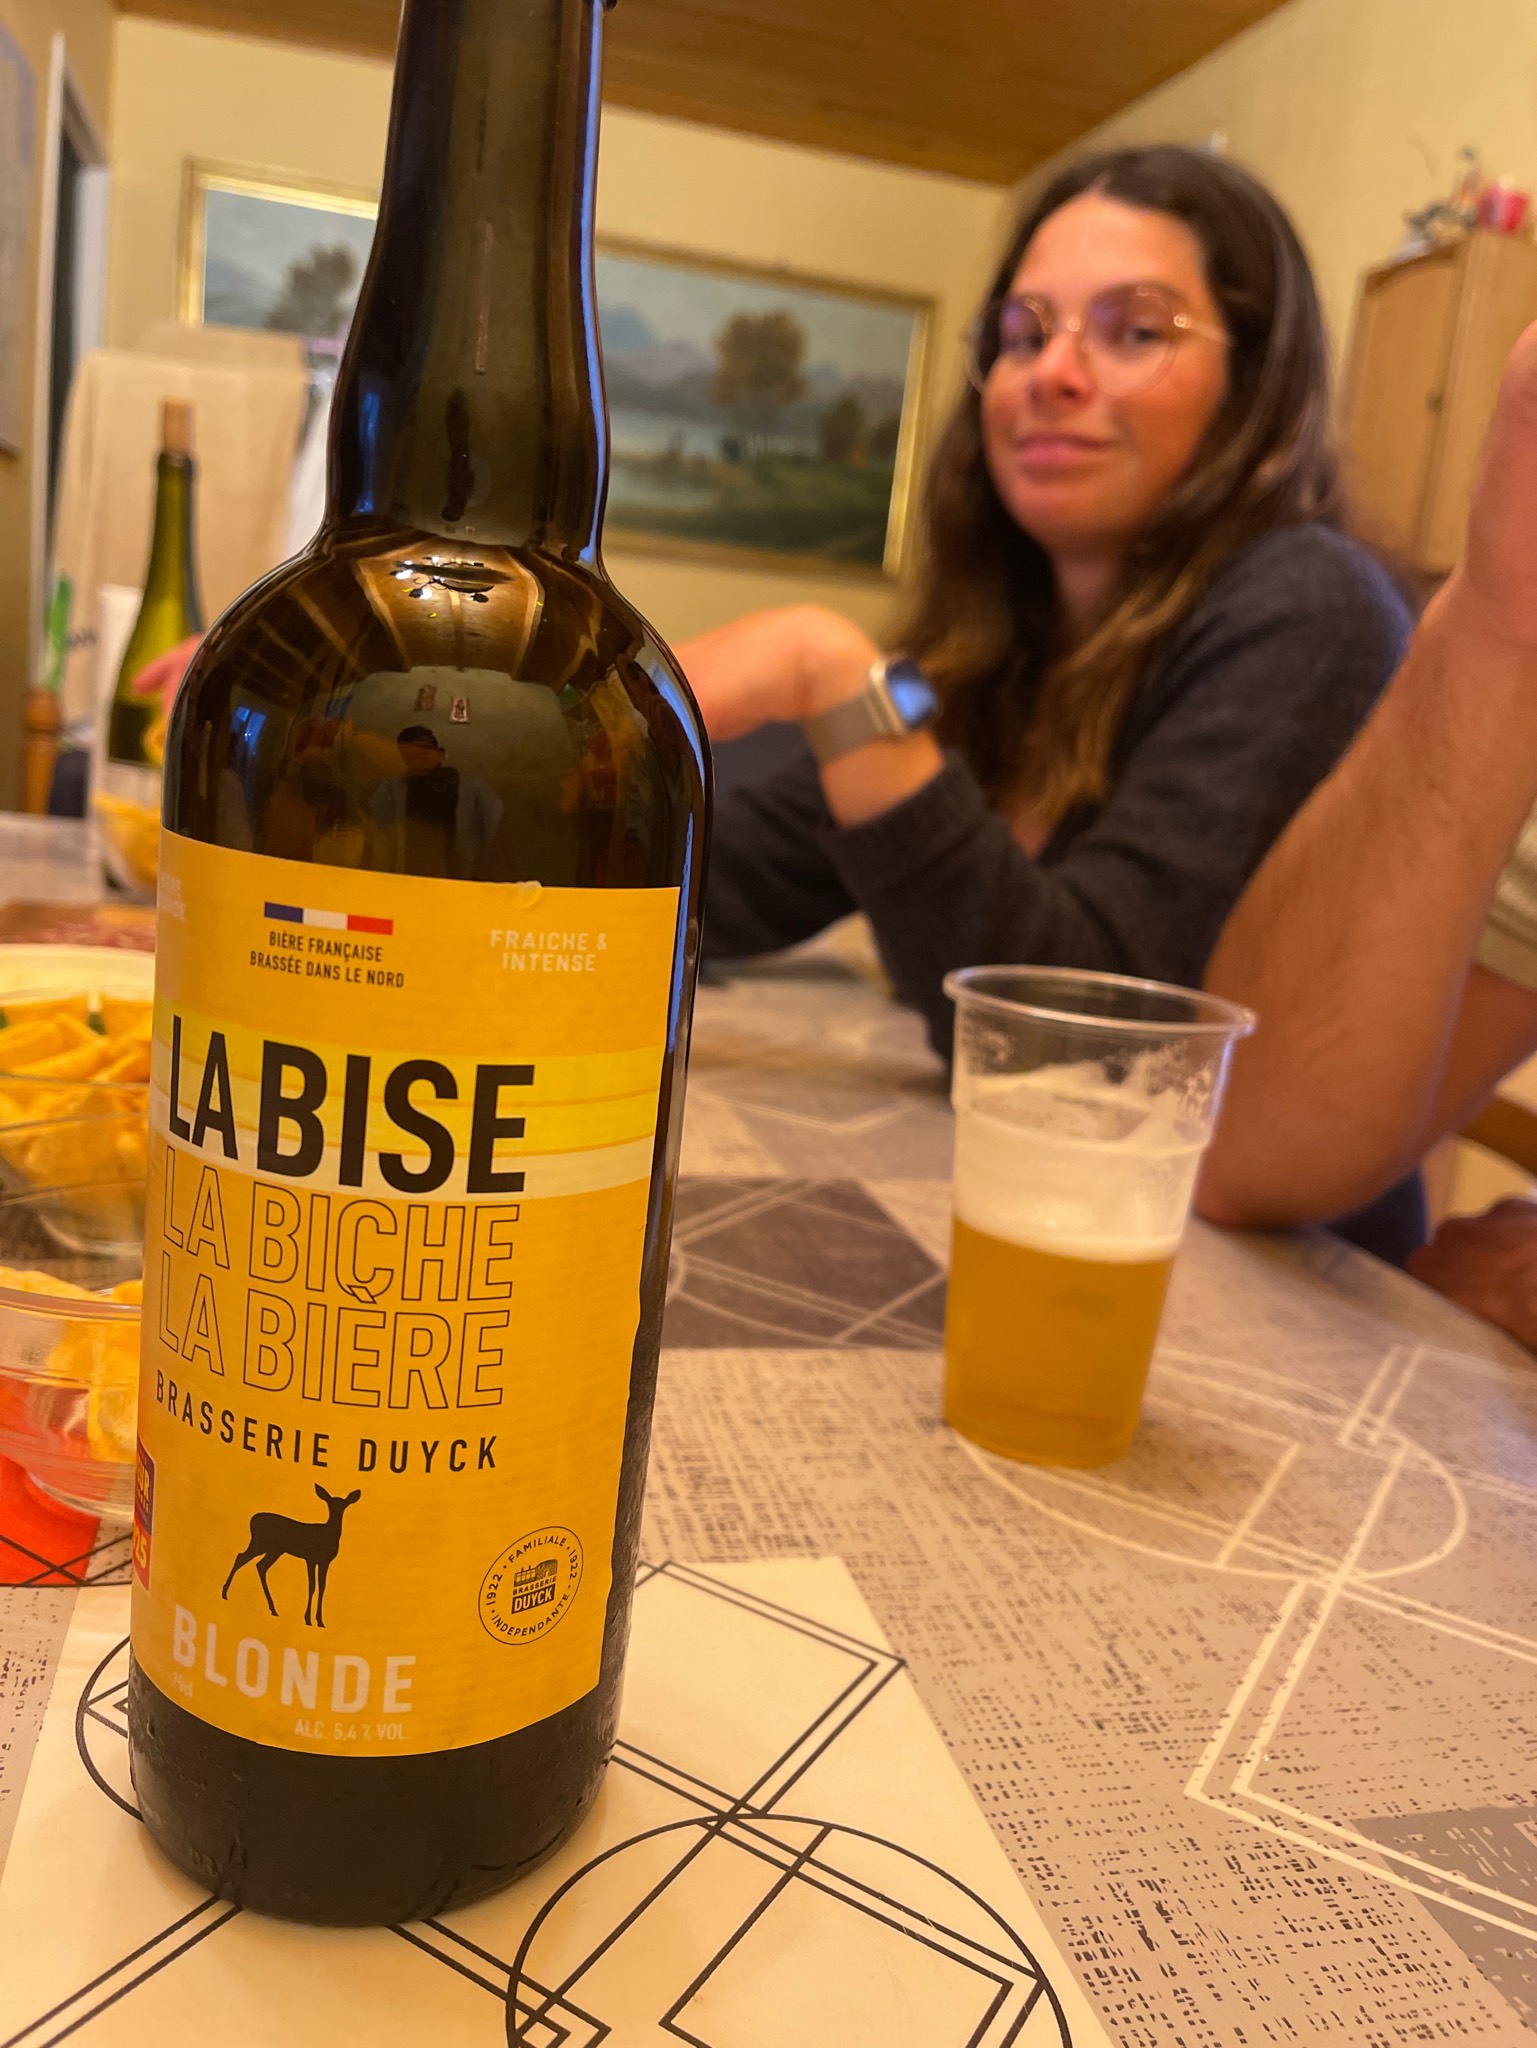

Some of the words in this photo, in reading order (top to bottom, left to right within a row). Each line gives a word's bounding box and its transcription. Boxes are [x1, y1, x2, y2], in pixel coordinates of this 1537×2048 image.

[269, 930, 304, 952] BIÈRE
[308, 938, 384, 962] FRANÇAISE
[490, 929, 589, 951] FRAICHE
[596, 932, 607, 951] &
[250, 951, 302, 975] BRASSÉE
[306, 961, 341, 980] DANS
[346, 967, 362, 983] LE
[366, 970, 405, 988] NORD
[502, 952, 597, 972] INTENSE
[168, 1014, 239, 1160] LA
[256, 1040, 535, 1195] BISE
[163, 1145, 230, 1270] LA
[248, 1181, 521, 1303] BICHE
[158, 1251, 225, 1377] LA
[242, 1285, 510, 1410] BIÈRE
[156, 1369, 330, 1468] BRASSERIE
[358, 1436, 498, 1474] DUYCK
[508, 1535, 567, 1563] FAMILIALE
[568, 1549, 578, 1580] 1922
[486, 1574, 503, 1605] 1922
[512, 1576, 557, 1596] BRASSERIE
[514, 1587, 553, 1612] DUYCK
[491, 1594, 570, 1637] INDEPENDANTE
[173, 1604, 417, 1714] BLONDE
